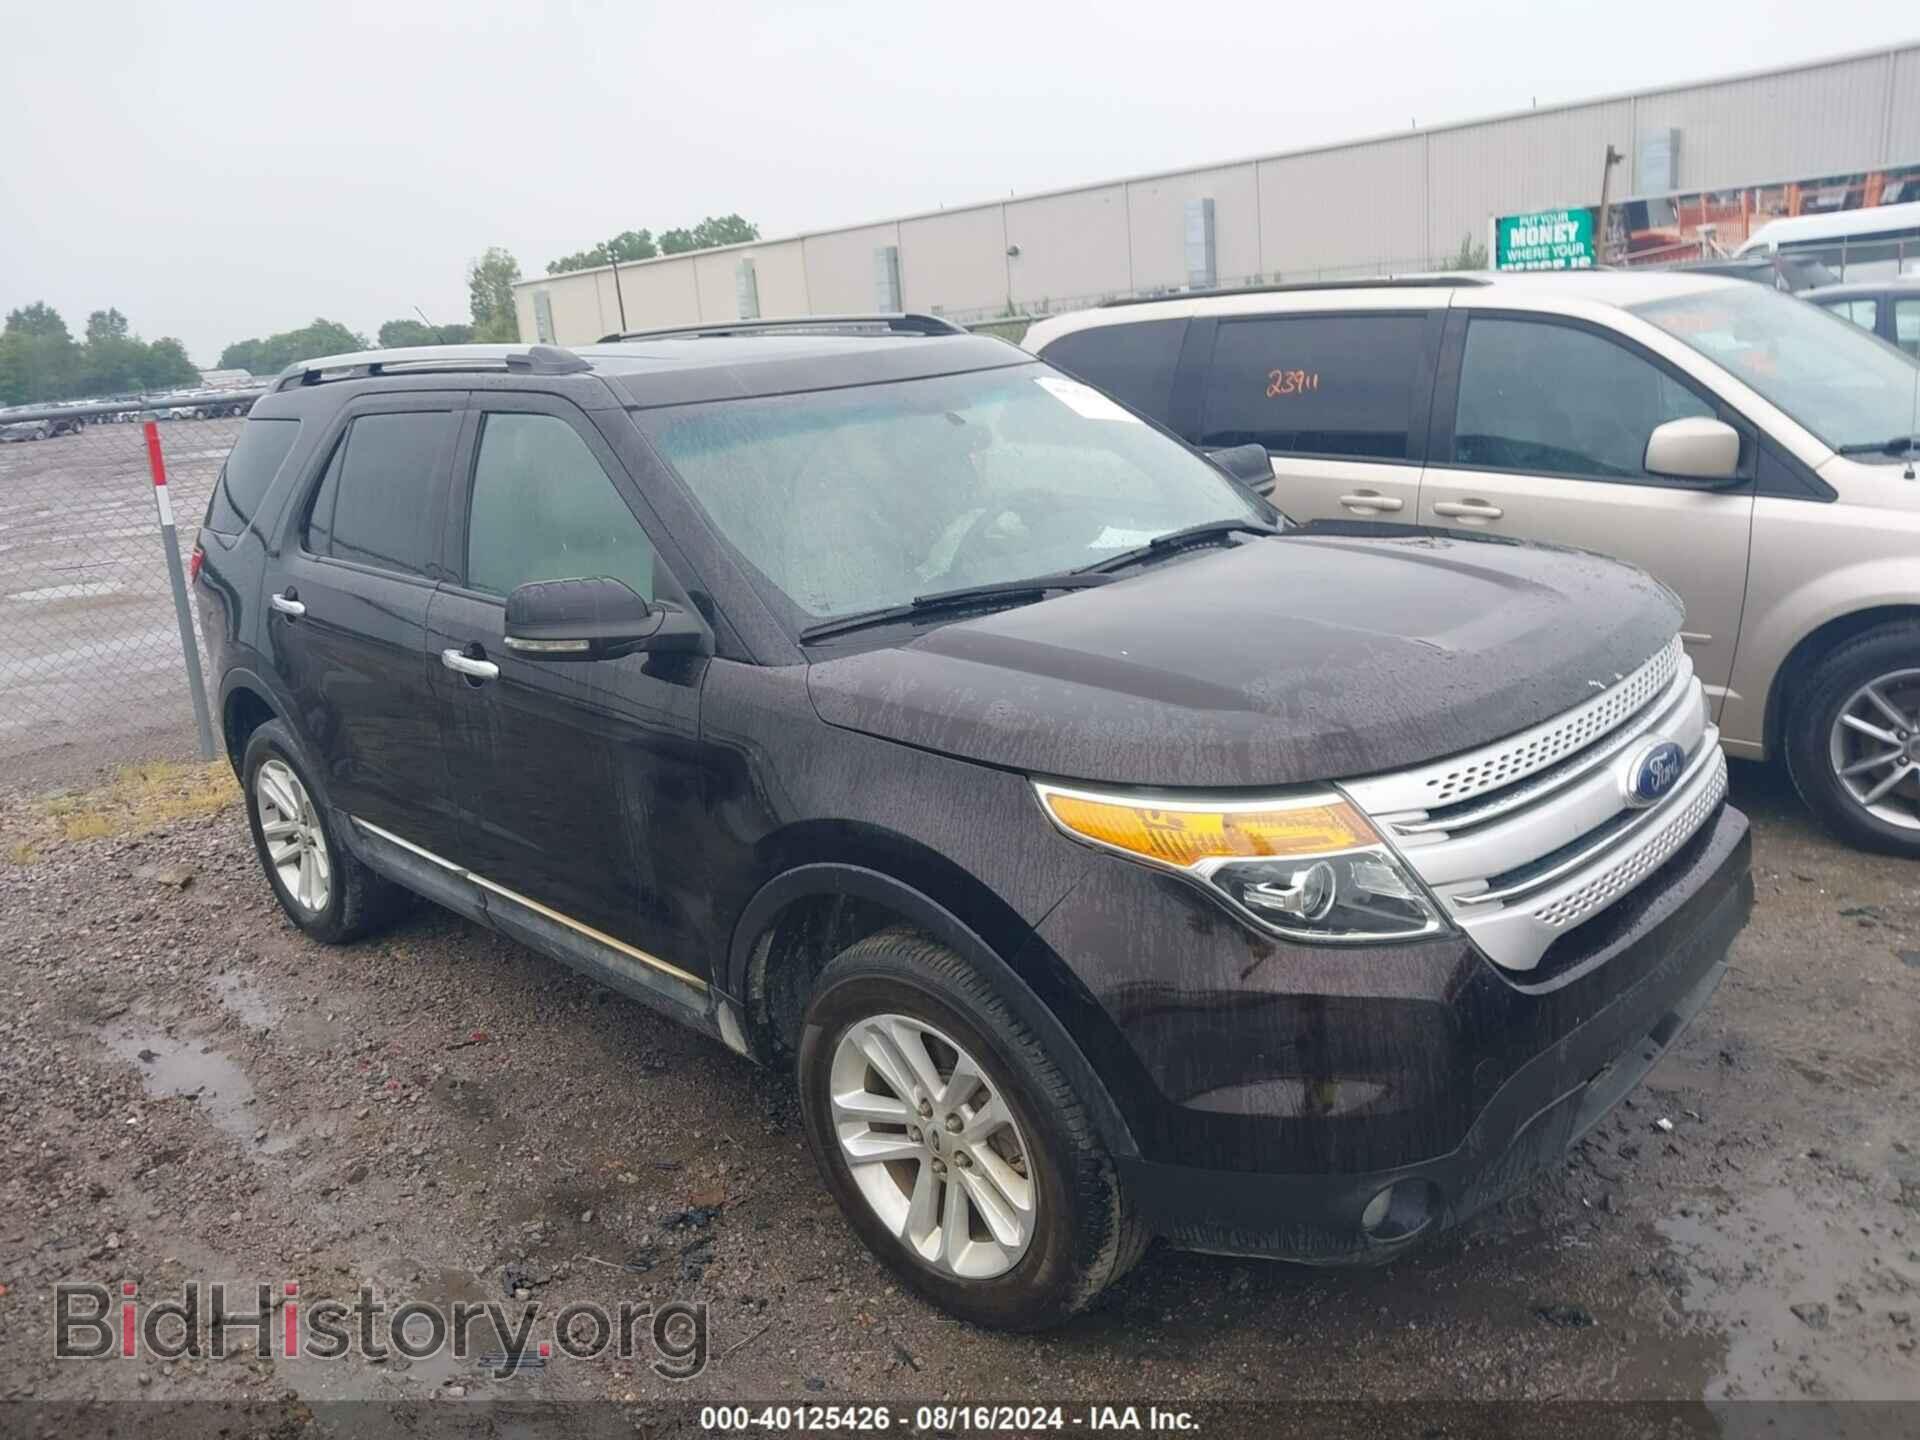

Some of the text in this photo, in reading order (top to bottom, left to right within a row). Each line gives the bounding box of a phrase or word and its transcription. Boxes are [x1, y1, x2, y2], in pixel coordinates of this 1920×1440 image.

[1510, 221, 1579, 248] MONEY
[1506, 242, 1585, 261] WHERE YOUR
[1647, 750, 1680, 793] Ford
